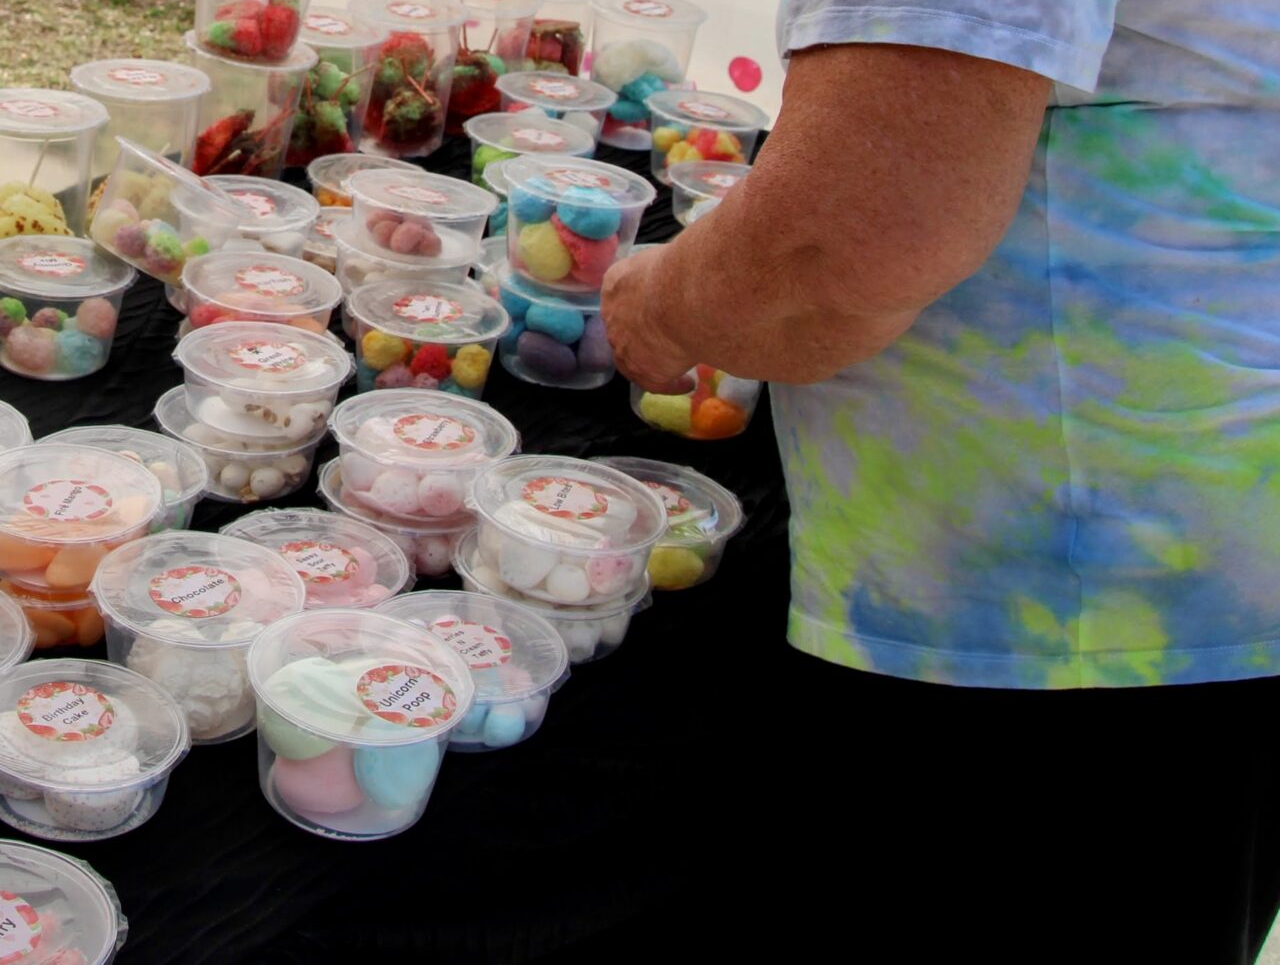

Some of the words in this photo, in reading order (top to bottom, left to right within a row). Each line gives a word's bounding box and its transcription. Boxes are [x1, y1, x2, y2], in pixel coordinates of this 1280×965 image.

[63, 486, 83, 507] Mango
[170, 577, 225, 605] Chocolate
[444, 629, 465, 642] erries
[459, 641, 483, 656] Cream
[378, 677, 419, 708] Unicorn
[402, 690, 431, 713] Poop
[42, 697, 85, 722] Birthday
[62, 709, 89, 725] Cake
